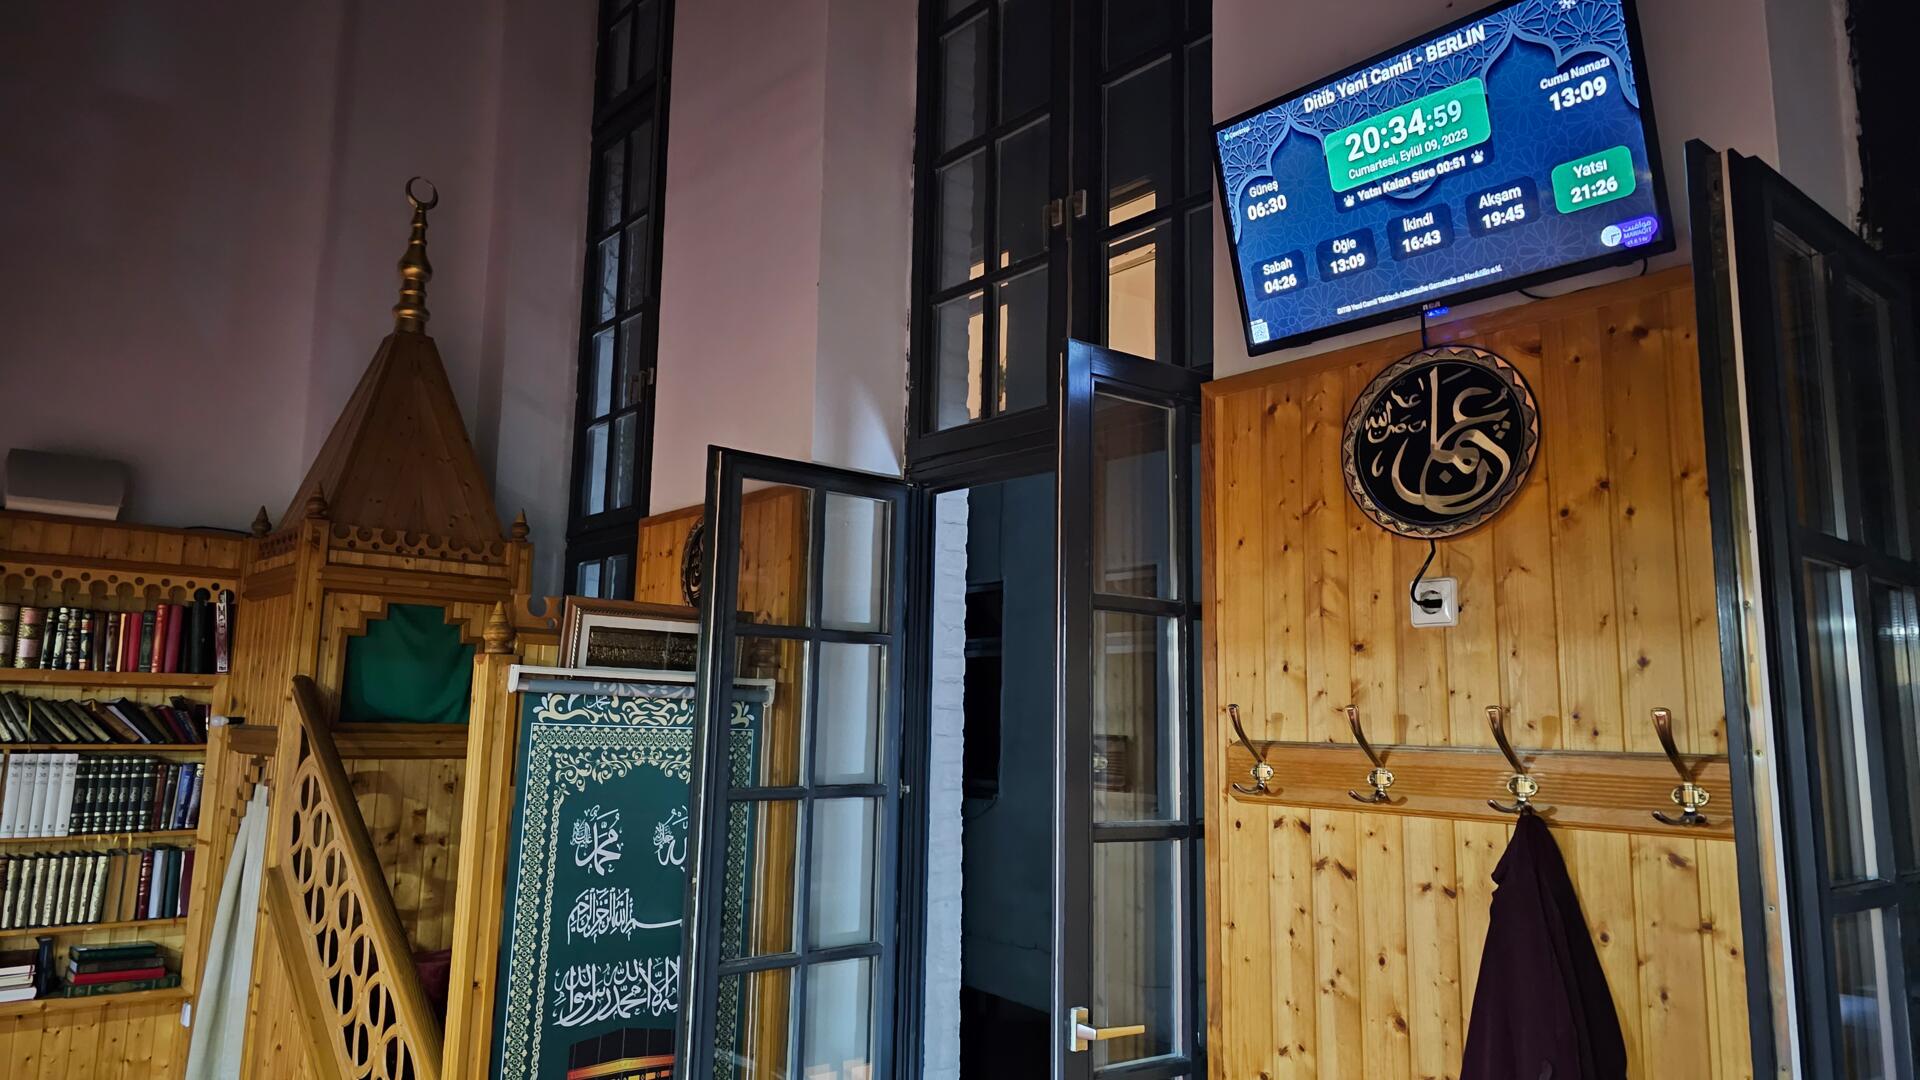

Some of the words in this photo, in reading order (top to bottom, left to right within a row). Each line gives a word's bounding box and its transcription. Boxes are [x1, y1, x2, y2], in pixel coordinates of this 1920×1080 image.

[1303, 90, 1335, 113] Ditib
[1337, 73, 1368, 98] Yeni
[1370, 56, 1413, 85] Camii
[1425, 24, 1486, 62] BERLIN
[1540, 72, 1570, 89] Cuma
[1570, 57, 1610, 79] Namazı
[1549, 76, 1607, 111] 13:09
[1345, 99, 1462, 162] 20:34:59
[1348, 154, 1399, 180] Cumartesi,
[1400, 143, 1423, 163] Eylül
[1424, 140, 1441, 153] 09,
[1441, 128, 1468, 147] 2023
[1357, 187, 1382, 201] Yatsı
[1382, 177, 1411, 193] Kalan
[1412, 167, 1436, 183] Süre
[1436, 155, 1466, 175] 00:51
[1572, 159, 1608, 178] Yatsı
[1249, 180, 1279, 198] Güneş
[1478, 186, 1522, 209] Akşam
[1570, 175, 1618, 203] 21:26
[1247, 194, 1287, 221] 06:30
[1482, 204, 1526, 229] 19:45
[1402, 211, 1434, 232] İkindi
[1332, 238, 1357, 254] Öğle
[1402, 229, 1441, 253] 16:43
[1262, 257, 1293, 276] Sabah
[1330, 253, 1365, 274] 13:09
[1264, 273, 1297, 294] 04:26
